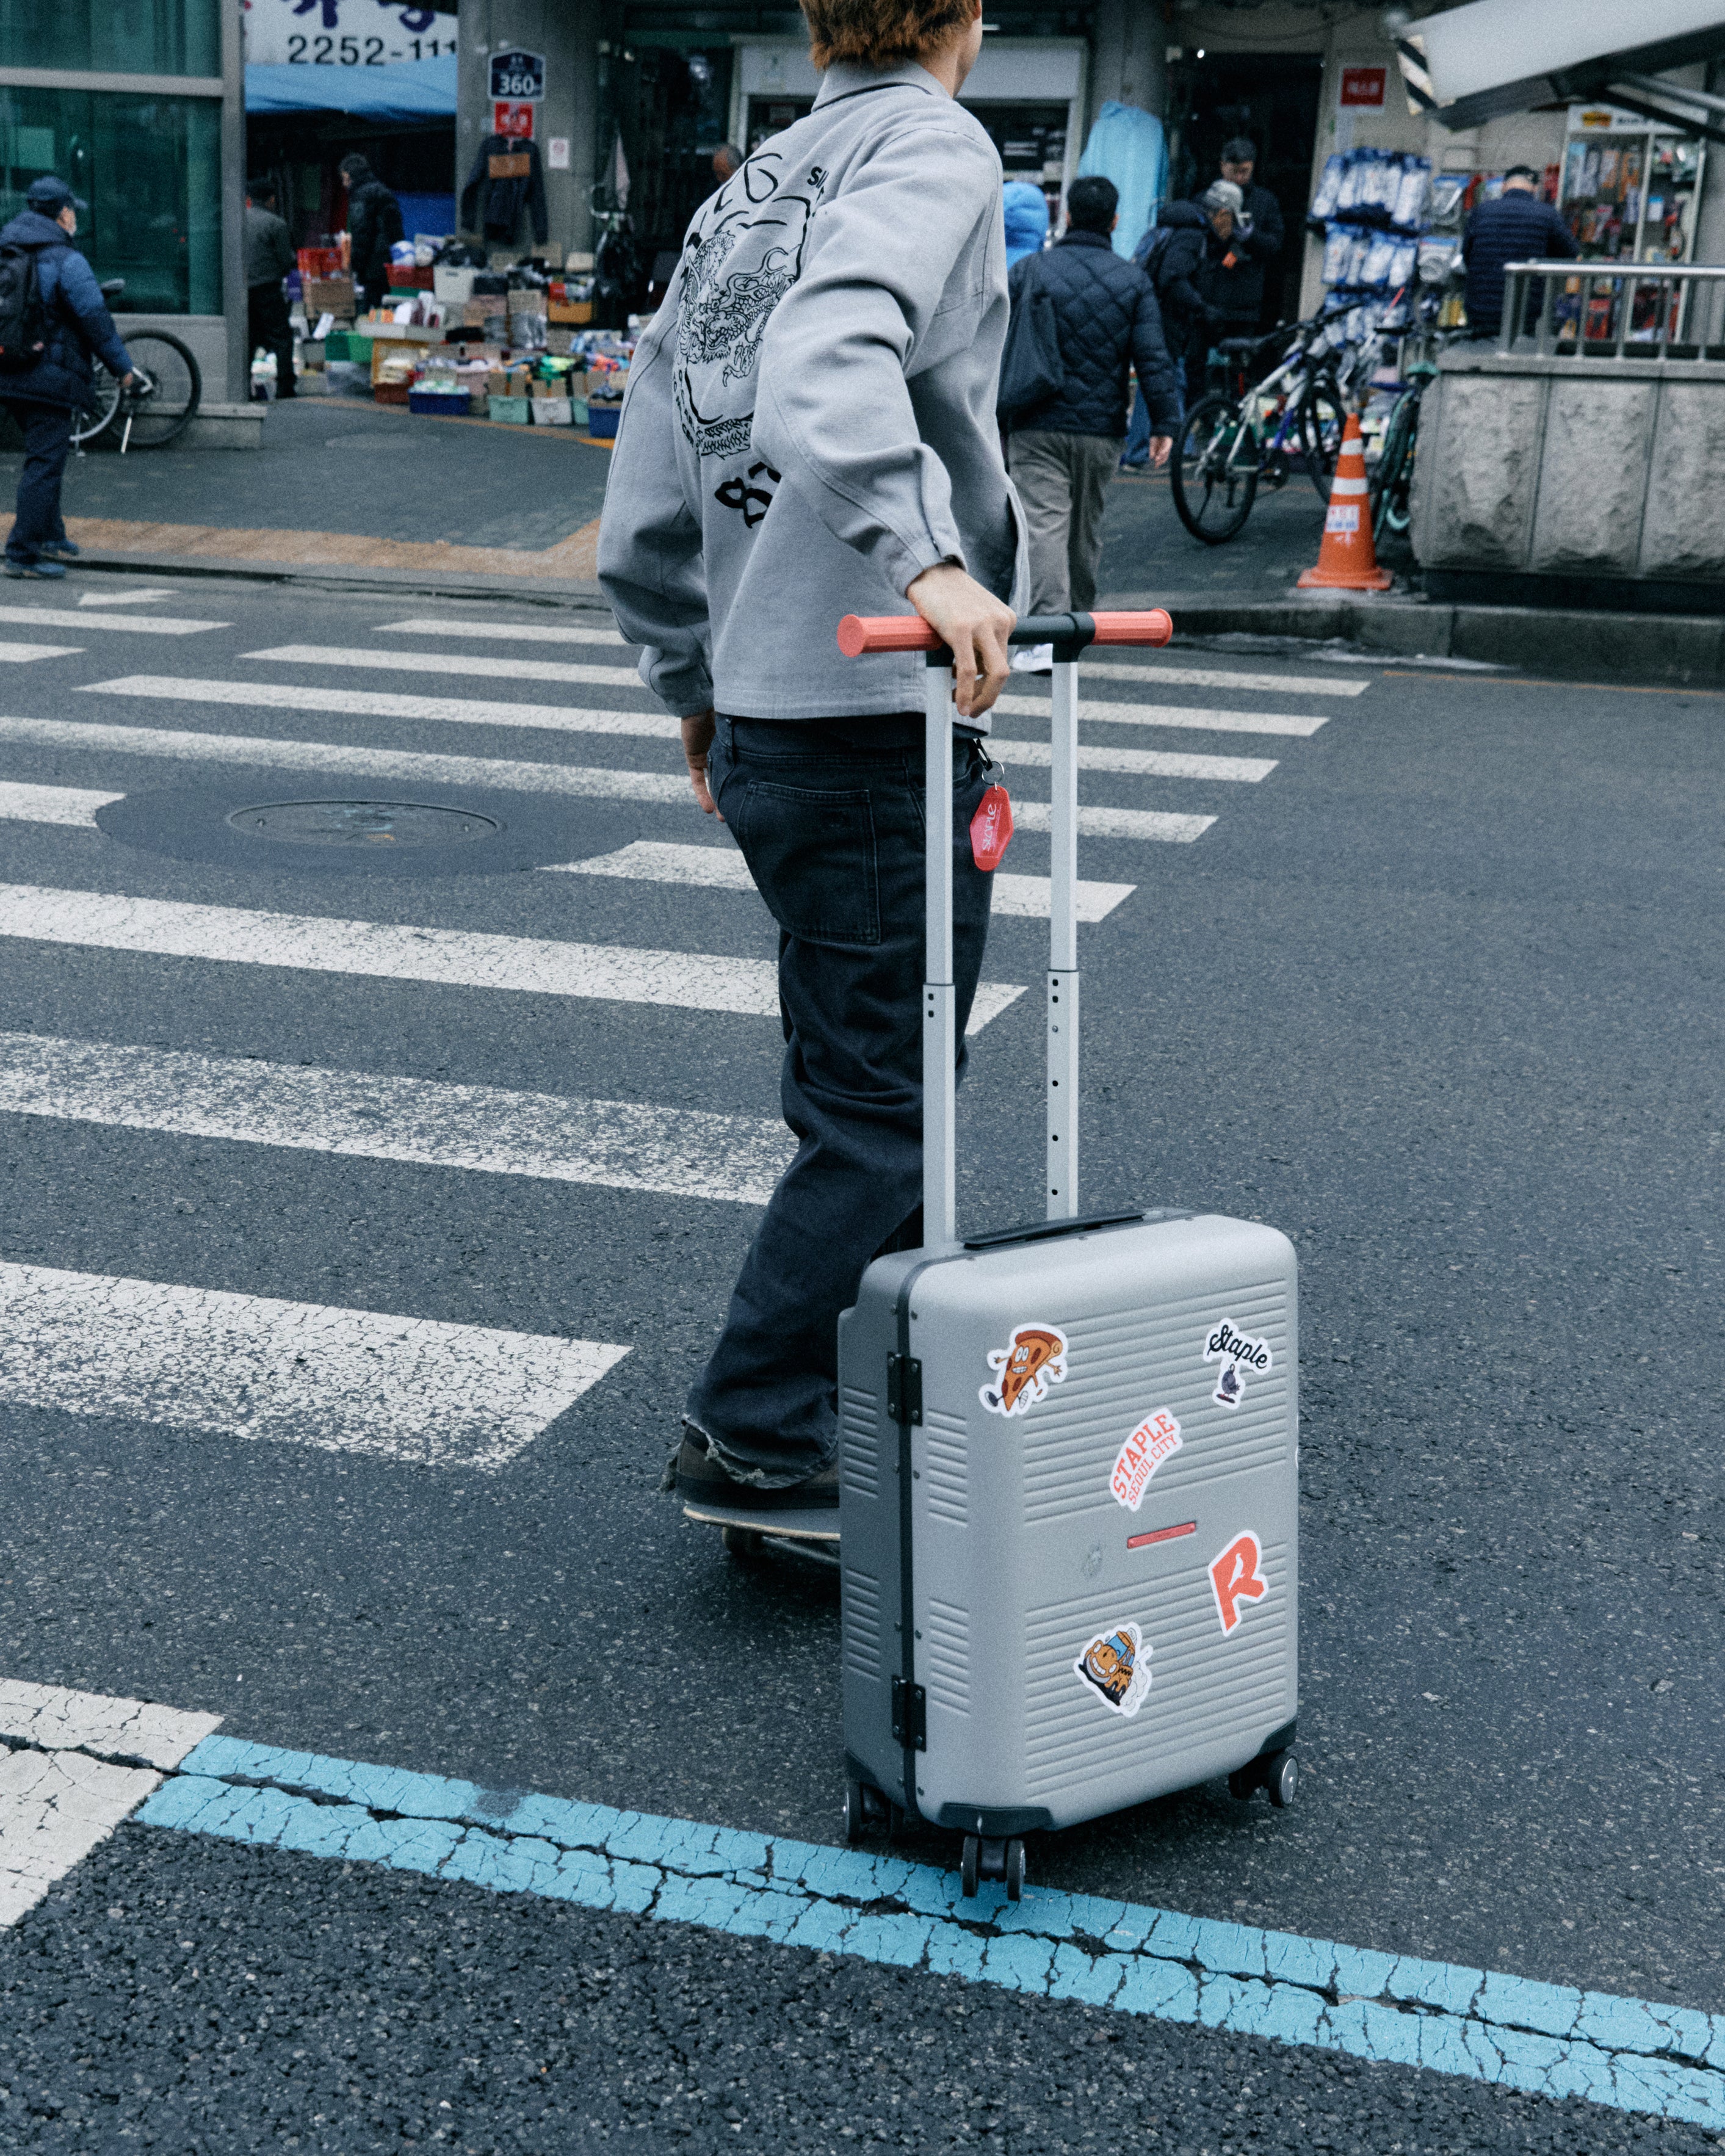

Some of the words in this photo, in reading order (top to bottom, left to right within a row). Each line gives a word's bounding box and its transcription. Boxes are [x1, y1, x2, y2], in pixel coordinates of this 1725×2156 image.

[499, 74, 534, 95] 360
[1207, 1324, 1268, 1369] Staple
[1113, 1414, 1176, 1499] STAPLE
[1129, 1458, 1154, 1505] SEOUL
[1151, 1434, 1177, 1460] CITY
